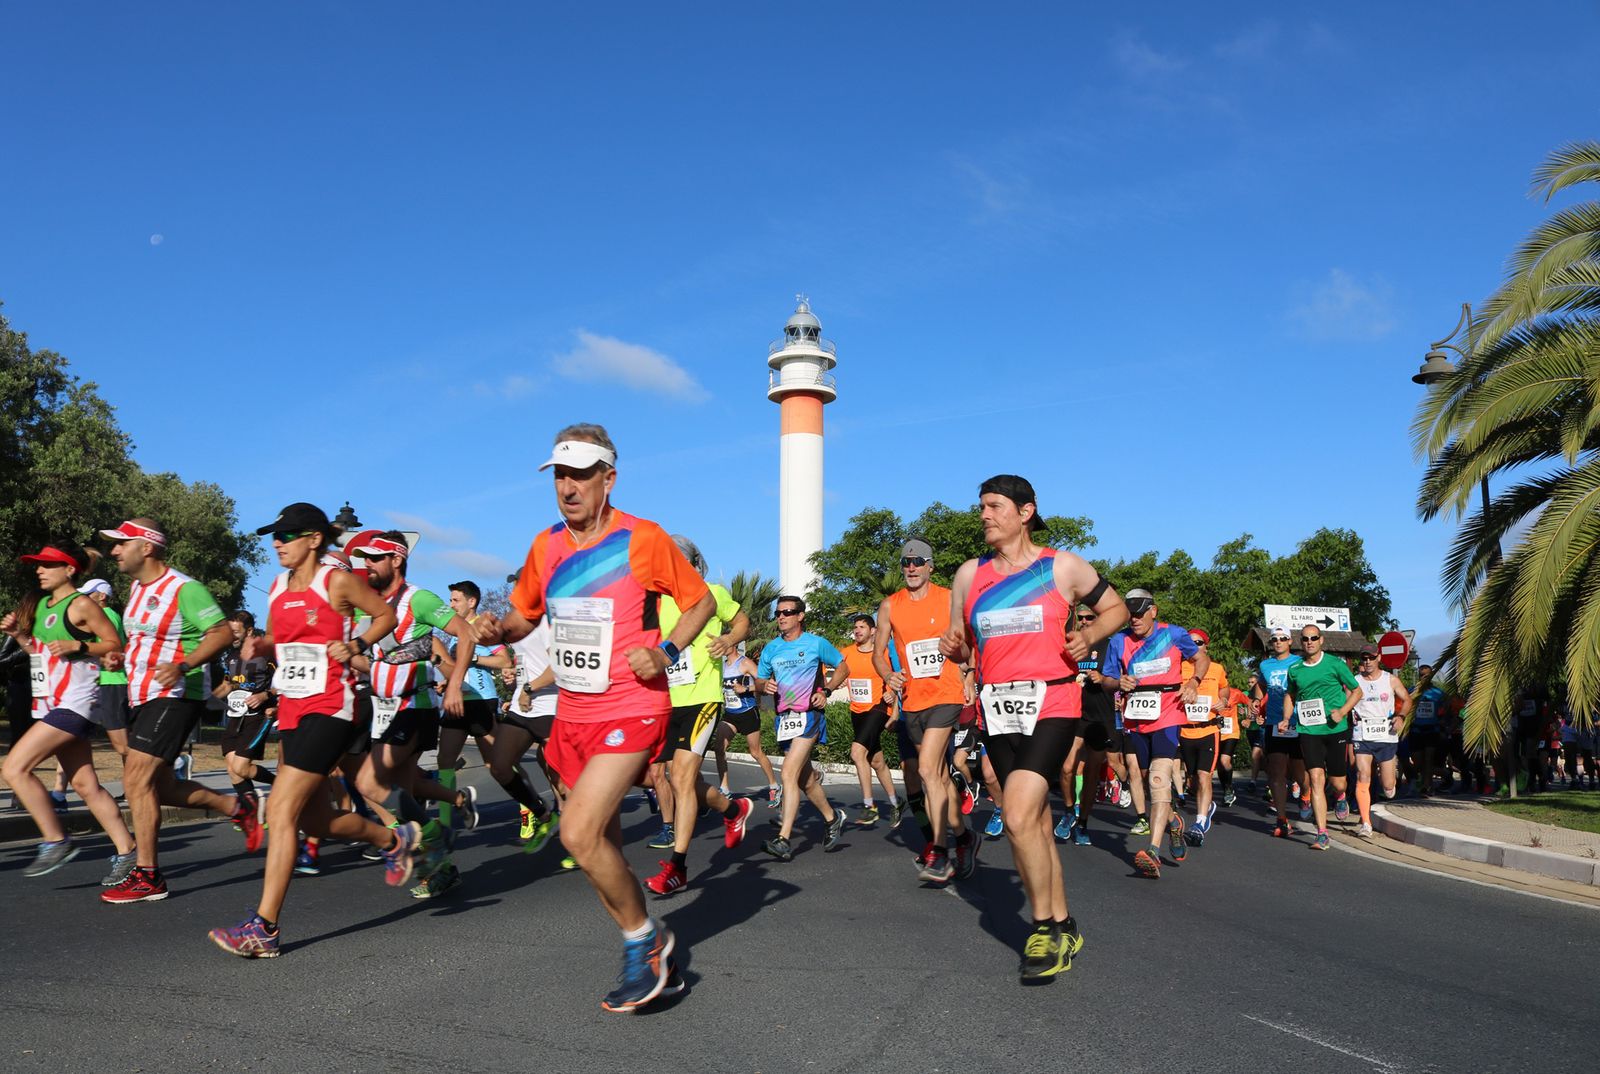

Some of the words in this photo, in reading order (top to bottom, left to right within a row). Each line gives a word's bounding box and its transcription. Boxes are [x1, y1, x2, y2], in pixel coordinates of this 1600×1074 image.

[555, 648, 601, 670] 1665
[913, 653, 945, 666] 1738
[282, 665, 317, 680] 1541
[667, 661, 689, 675] 644
[32, 671, 45, 682] 40
[992, 700, 1038, 716] 1625
[1130, 699, 1157, 709] 1702
[1186, 705, 1209, 714] 1509
[1301, 709, 1322, 718] 1503
